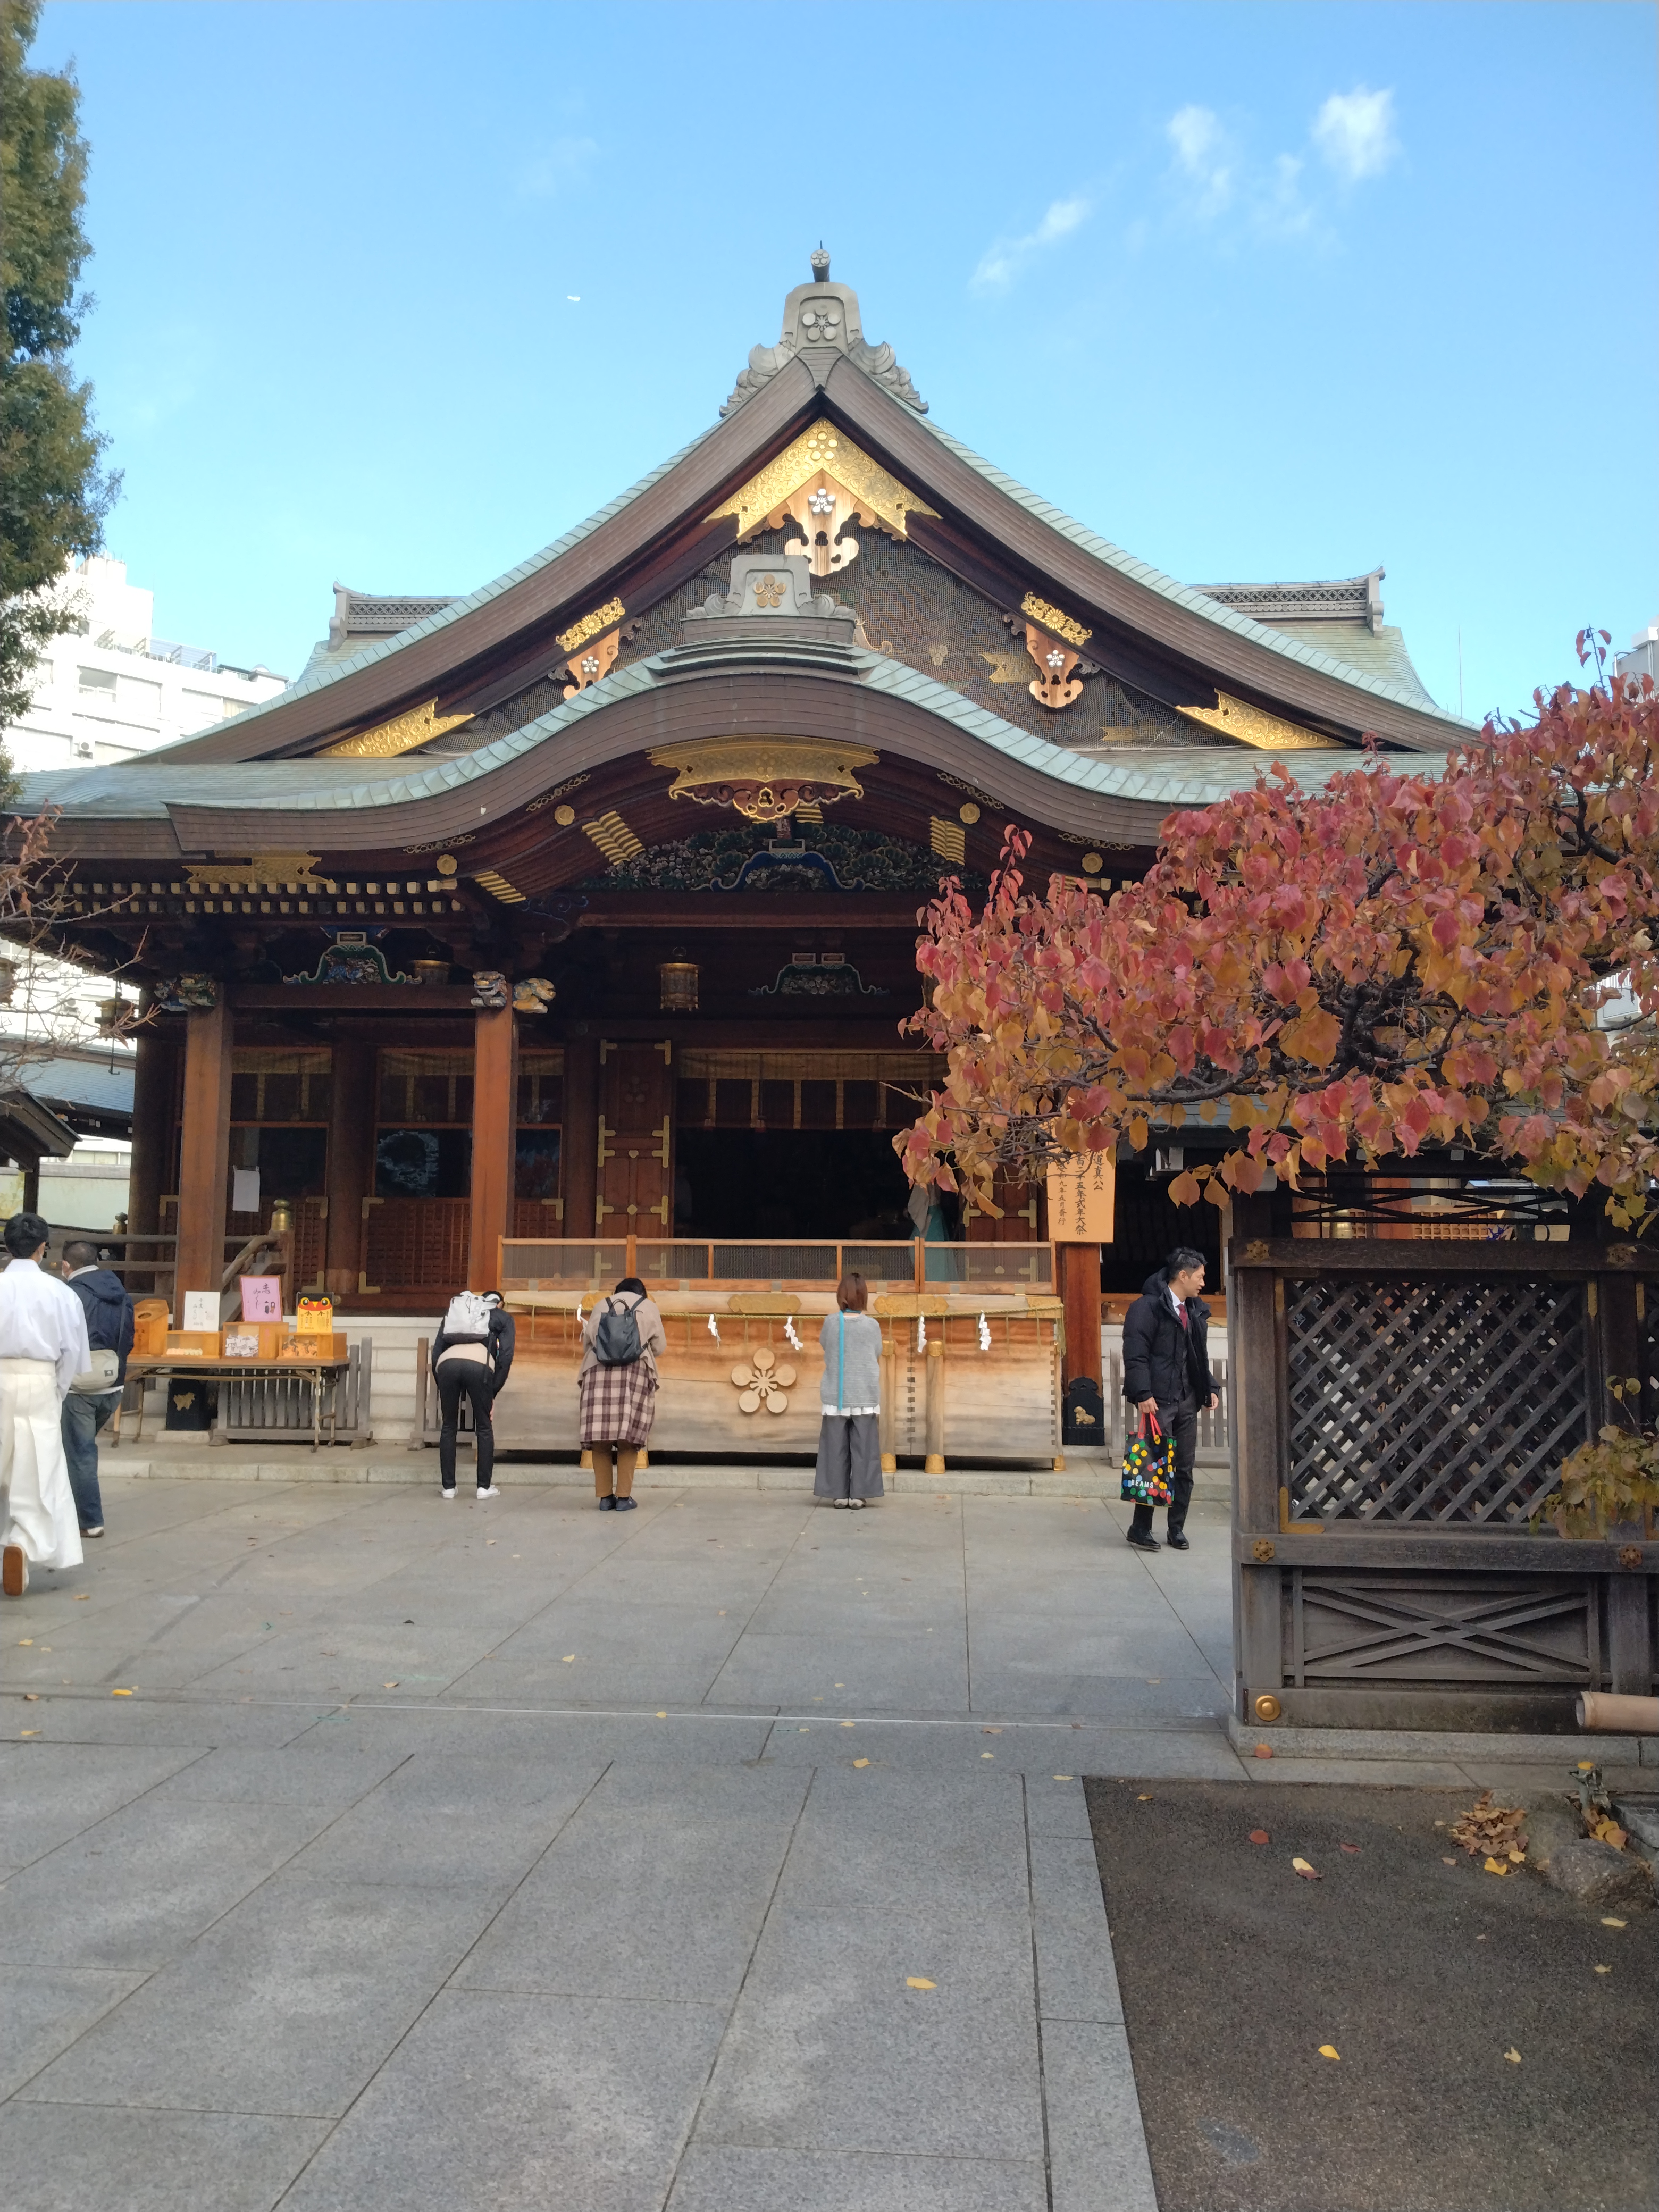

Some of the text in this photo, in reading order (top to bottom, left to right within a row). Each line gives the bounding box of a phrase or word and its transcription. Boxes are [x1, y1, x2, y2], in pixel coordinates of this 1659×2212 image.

[1093, 1150, 1104, 1191] 道真公
[1131, 1479, 1154, 1488] BEAMS
